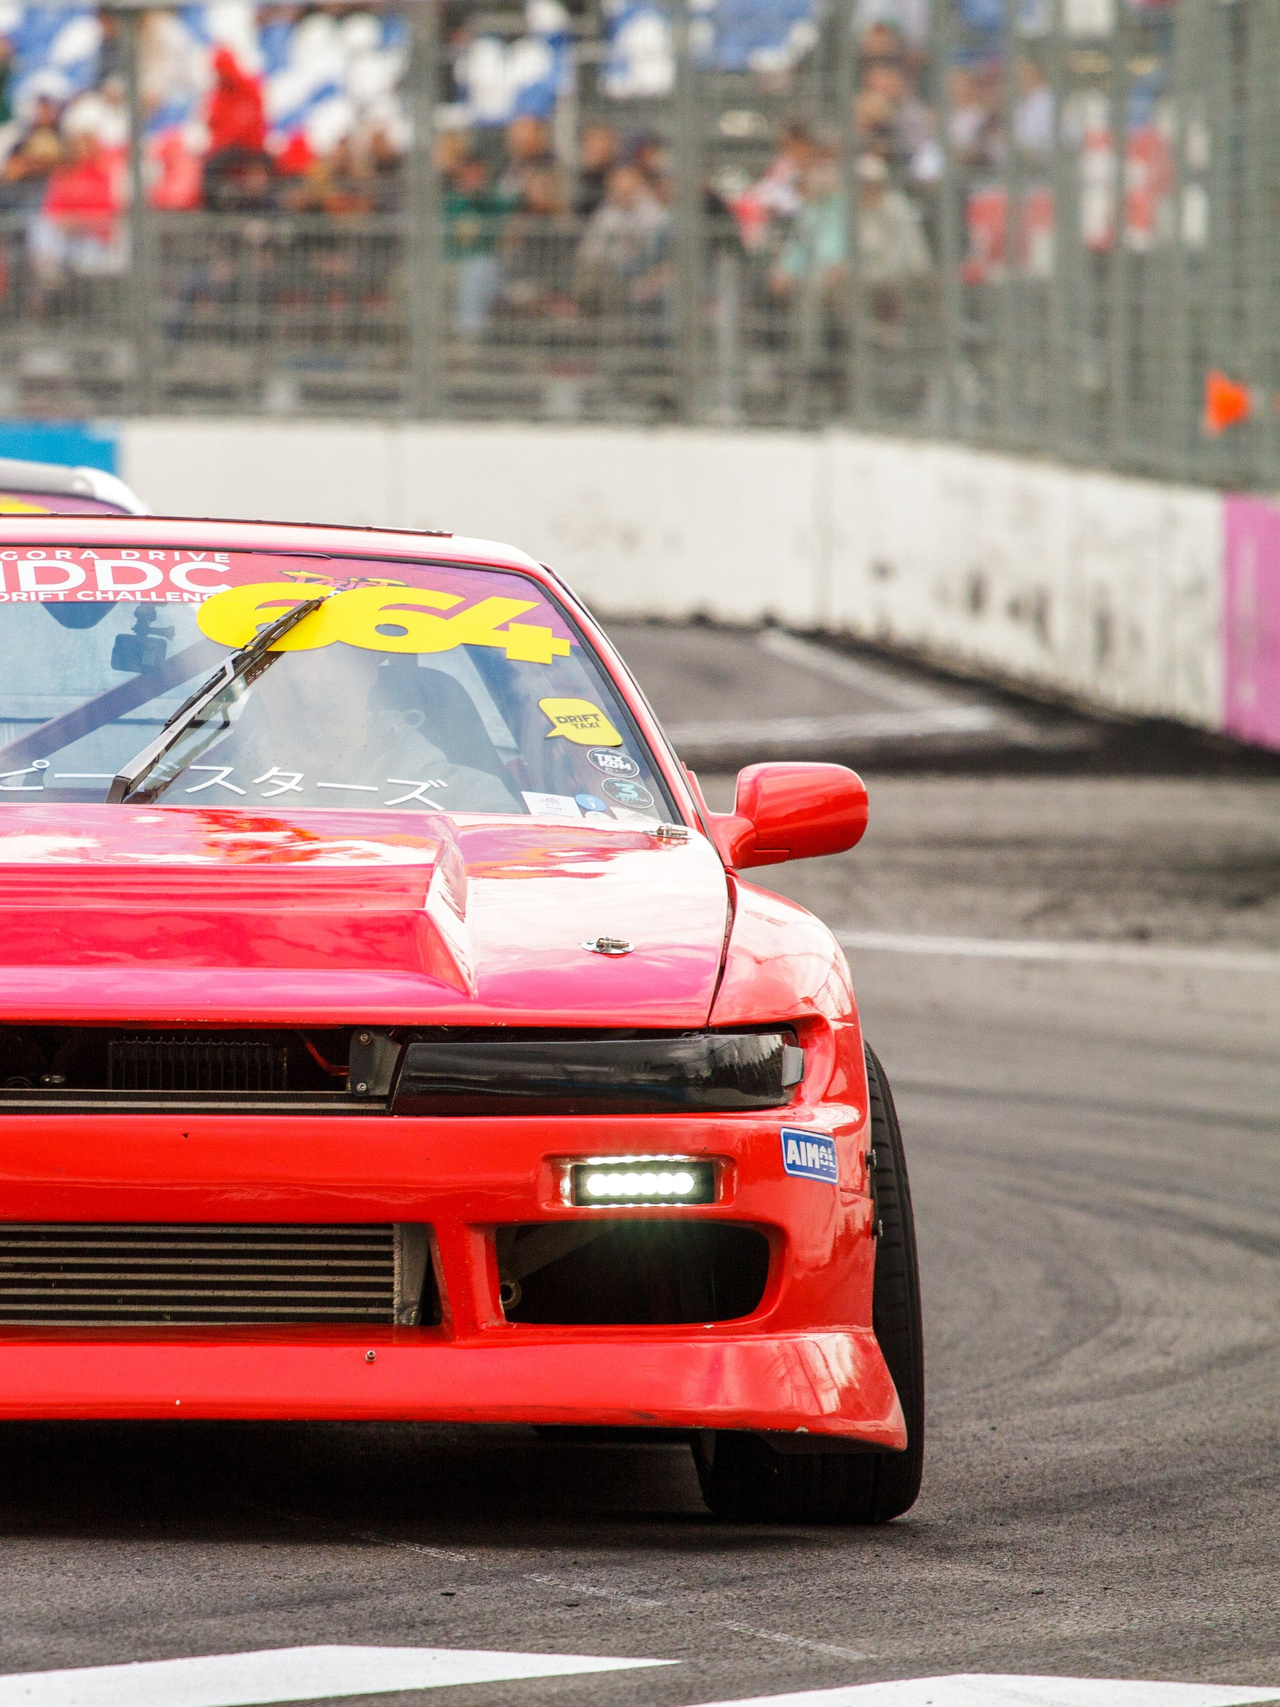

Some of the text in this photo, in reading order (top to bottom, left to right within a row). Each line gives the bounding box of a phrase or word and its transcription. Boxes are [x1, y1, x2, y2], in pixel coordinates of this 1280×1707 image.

[120, 550, 230, 563] DRIVE
[76, 591, 218, 602] CHALLEN
[196, 582, 570, 665] 664
[555, 714, 600, 724] DRIFT
[571, 722, 601, 730] TAXI
[786, 1139, 836, 1172] AIMOL
